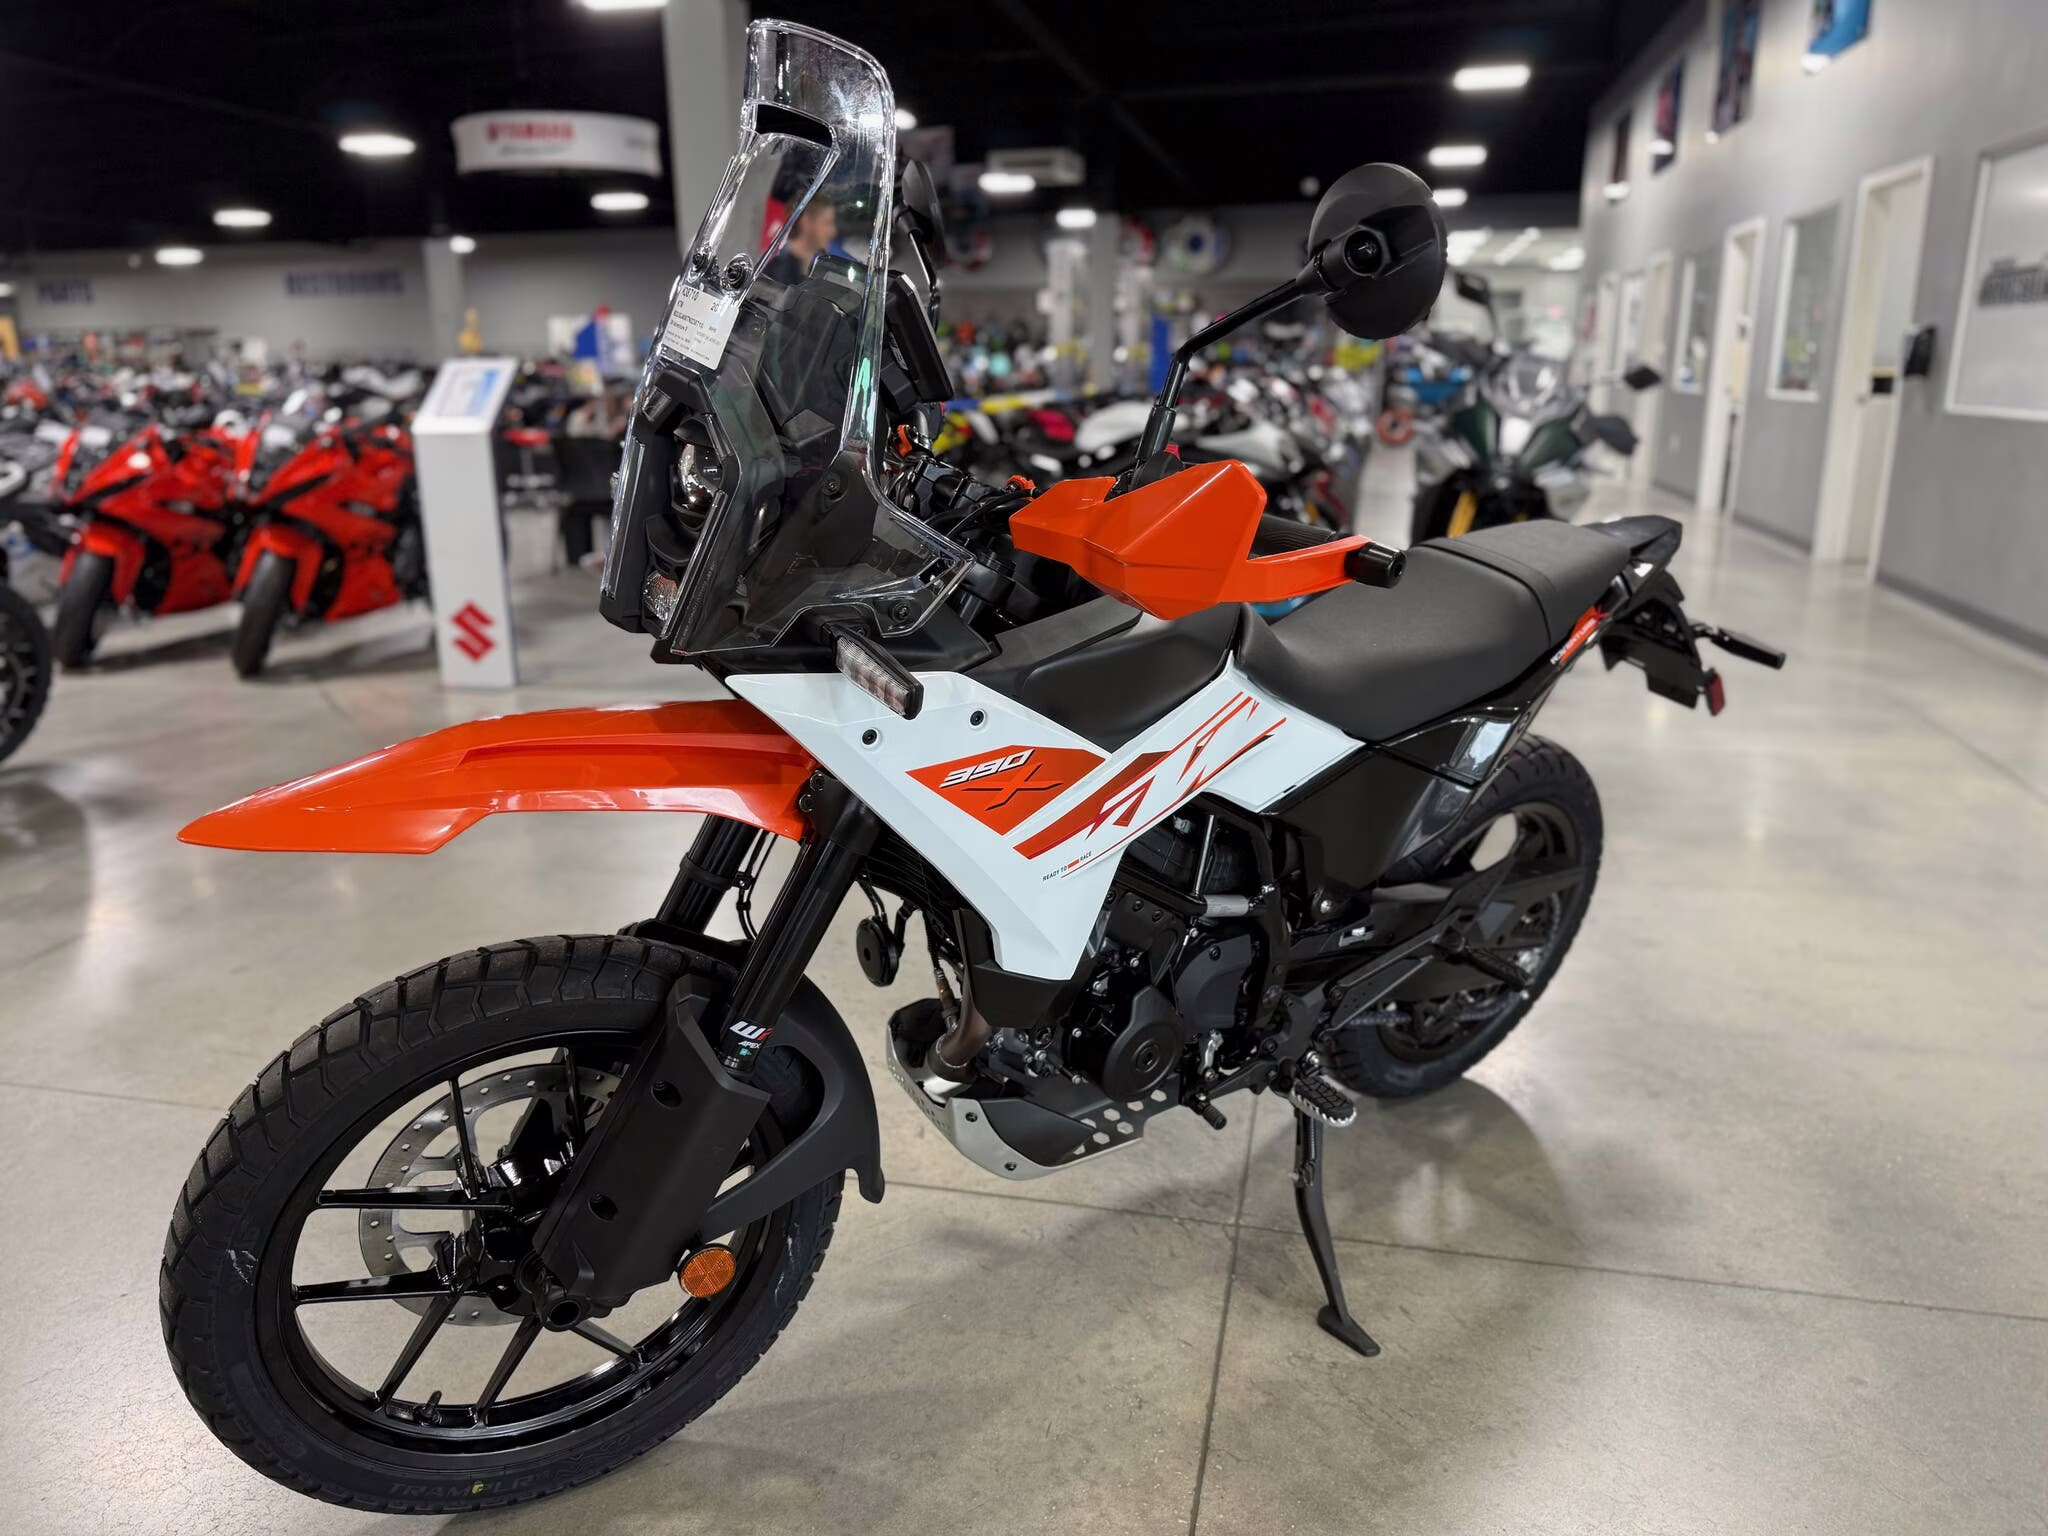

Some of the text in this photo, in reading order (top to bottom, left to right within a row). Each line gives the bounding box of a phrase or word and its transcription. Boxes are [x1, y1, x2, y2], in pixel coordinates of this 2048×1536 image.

[939, 748, 1036, 789] 390
[961, 762, 1064, 811] X
[1042, 850, 1092, 882] READY TO RACE
[737, 1040, 762, 1049] APEX
